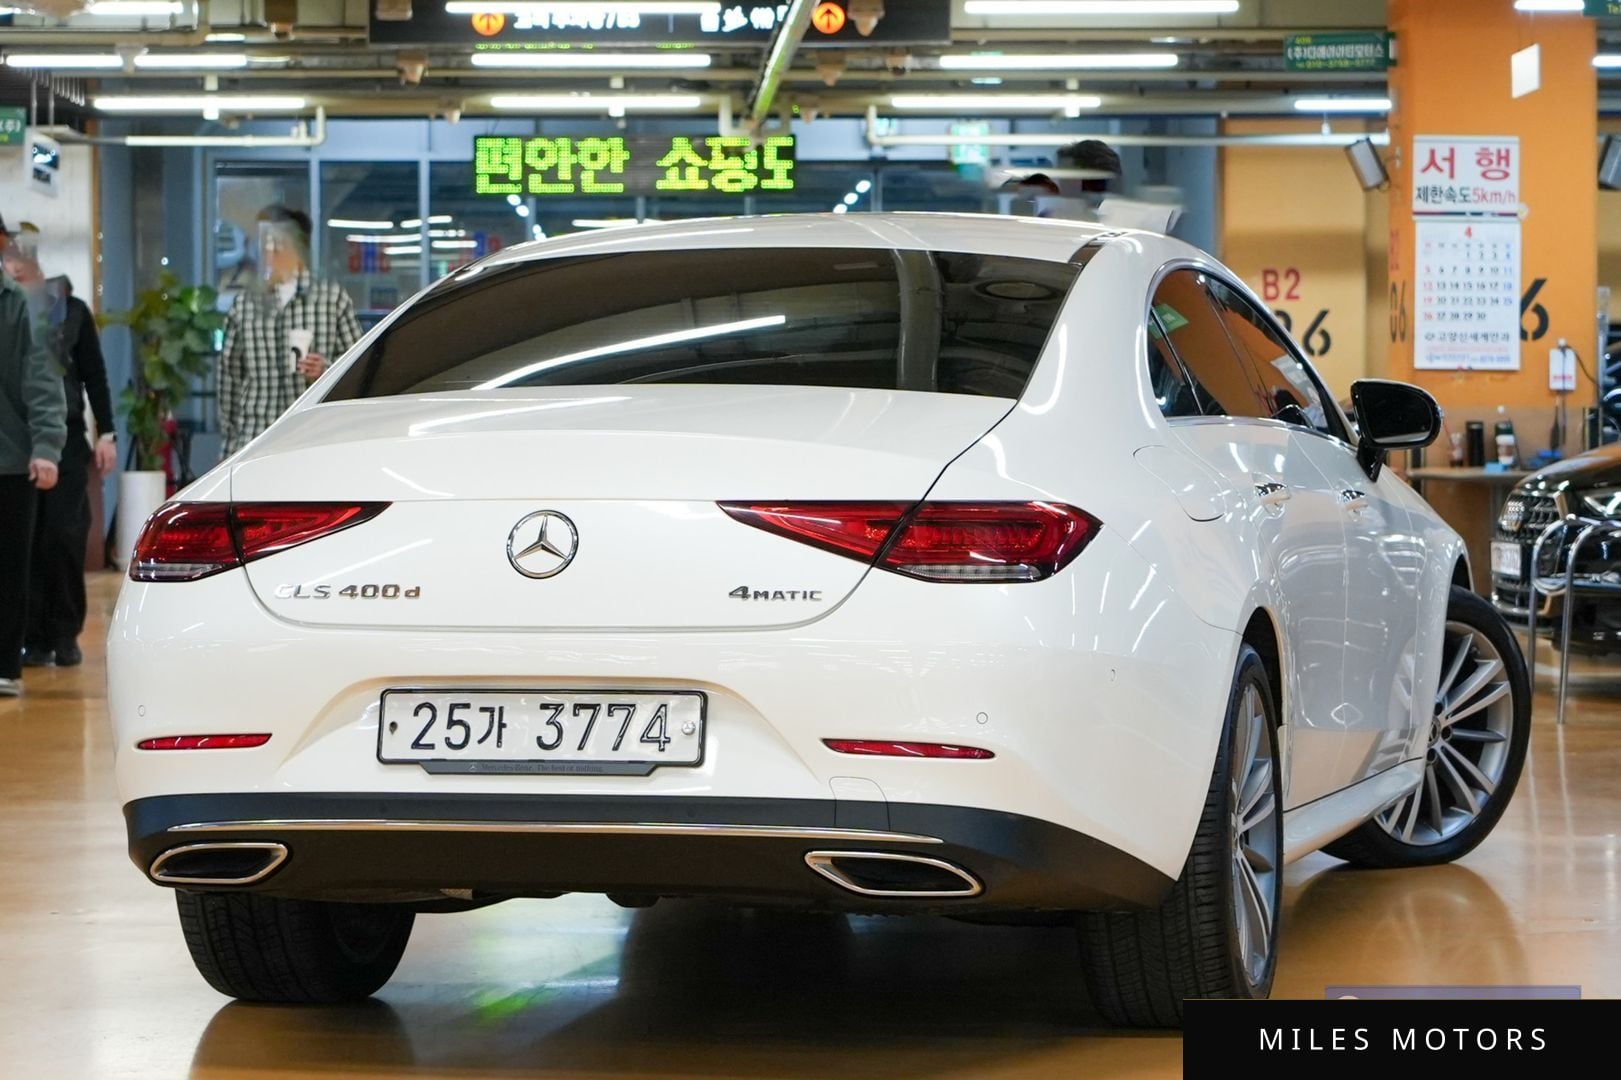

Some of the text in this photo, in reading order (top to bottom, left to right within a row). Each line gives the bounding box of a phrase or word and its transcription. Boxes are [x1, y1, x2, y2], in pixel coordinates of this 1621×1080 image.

[476, 137, 630, 193] 편안한
[1262, 269, 1301, 301] B2
[274, 584, 331, 599] CLS
[728, 585, 822, 601] 4MATIC
[410, 701, 671, 752] 25가 3774
